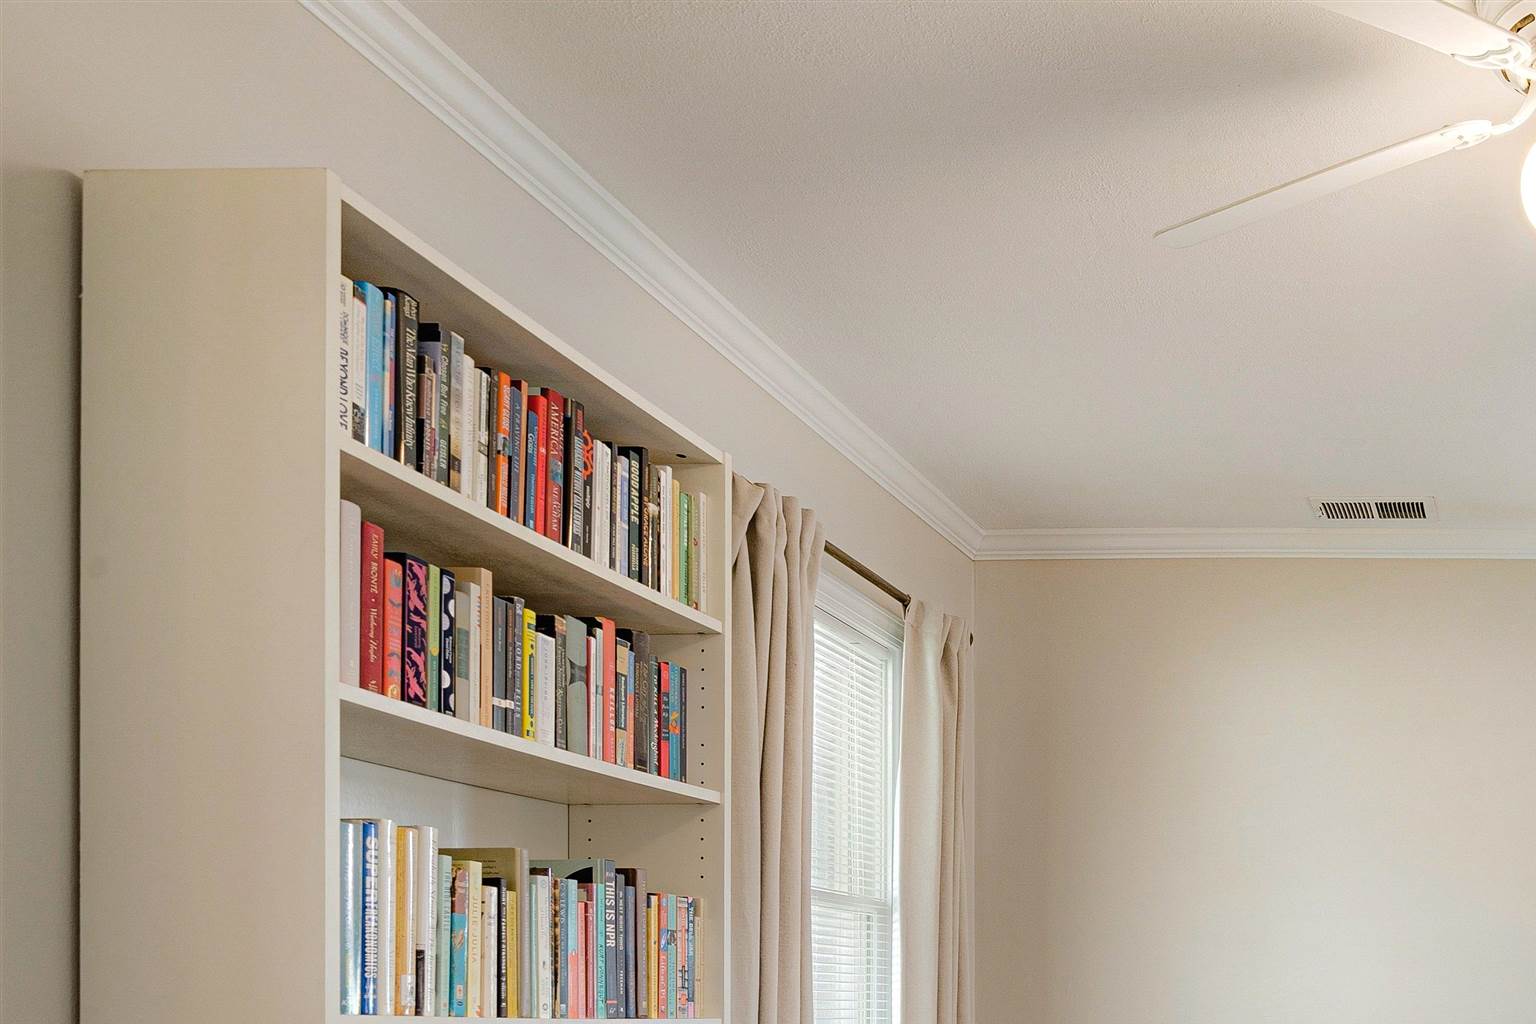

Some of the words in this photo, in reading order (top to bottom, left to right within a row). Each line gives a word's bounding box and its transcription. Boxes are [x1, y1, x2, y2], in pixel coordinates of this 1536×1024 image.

[405, 328, 416, 345] The
[405, 345, 416, 369] Man
[440, 356, 448, 383] Chosen
[405, 369, 416, 389] Who
[440, 384, 448, 399] But
[405, 390, 416, 416] Knew
[440, 399, 448, 416] Free
[403, 416, 416, 449] Infinity
[550, 403, 560, 457] AMERICA
[631, 461, 640, 489] GOOD
[631, 489, 640, 525] APPLE
[370, 533, 378, 559] EMILY
[606, 881, 616, 906] THIS
[364, 836, 378, 978] SUPERFREAKONOMICS
[606, 909, 616, 920] IS
[606, 924, 616, 948] NPR
